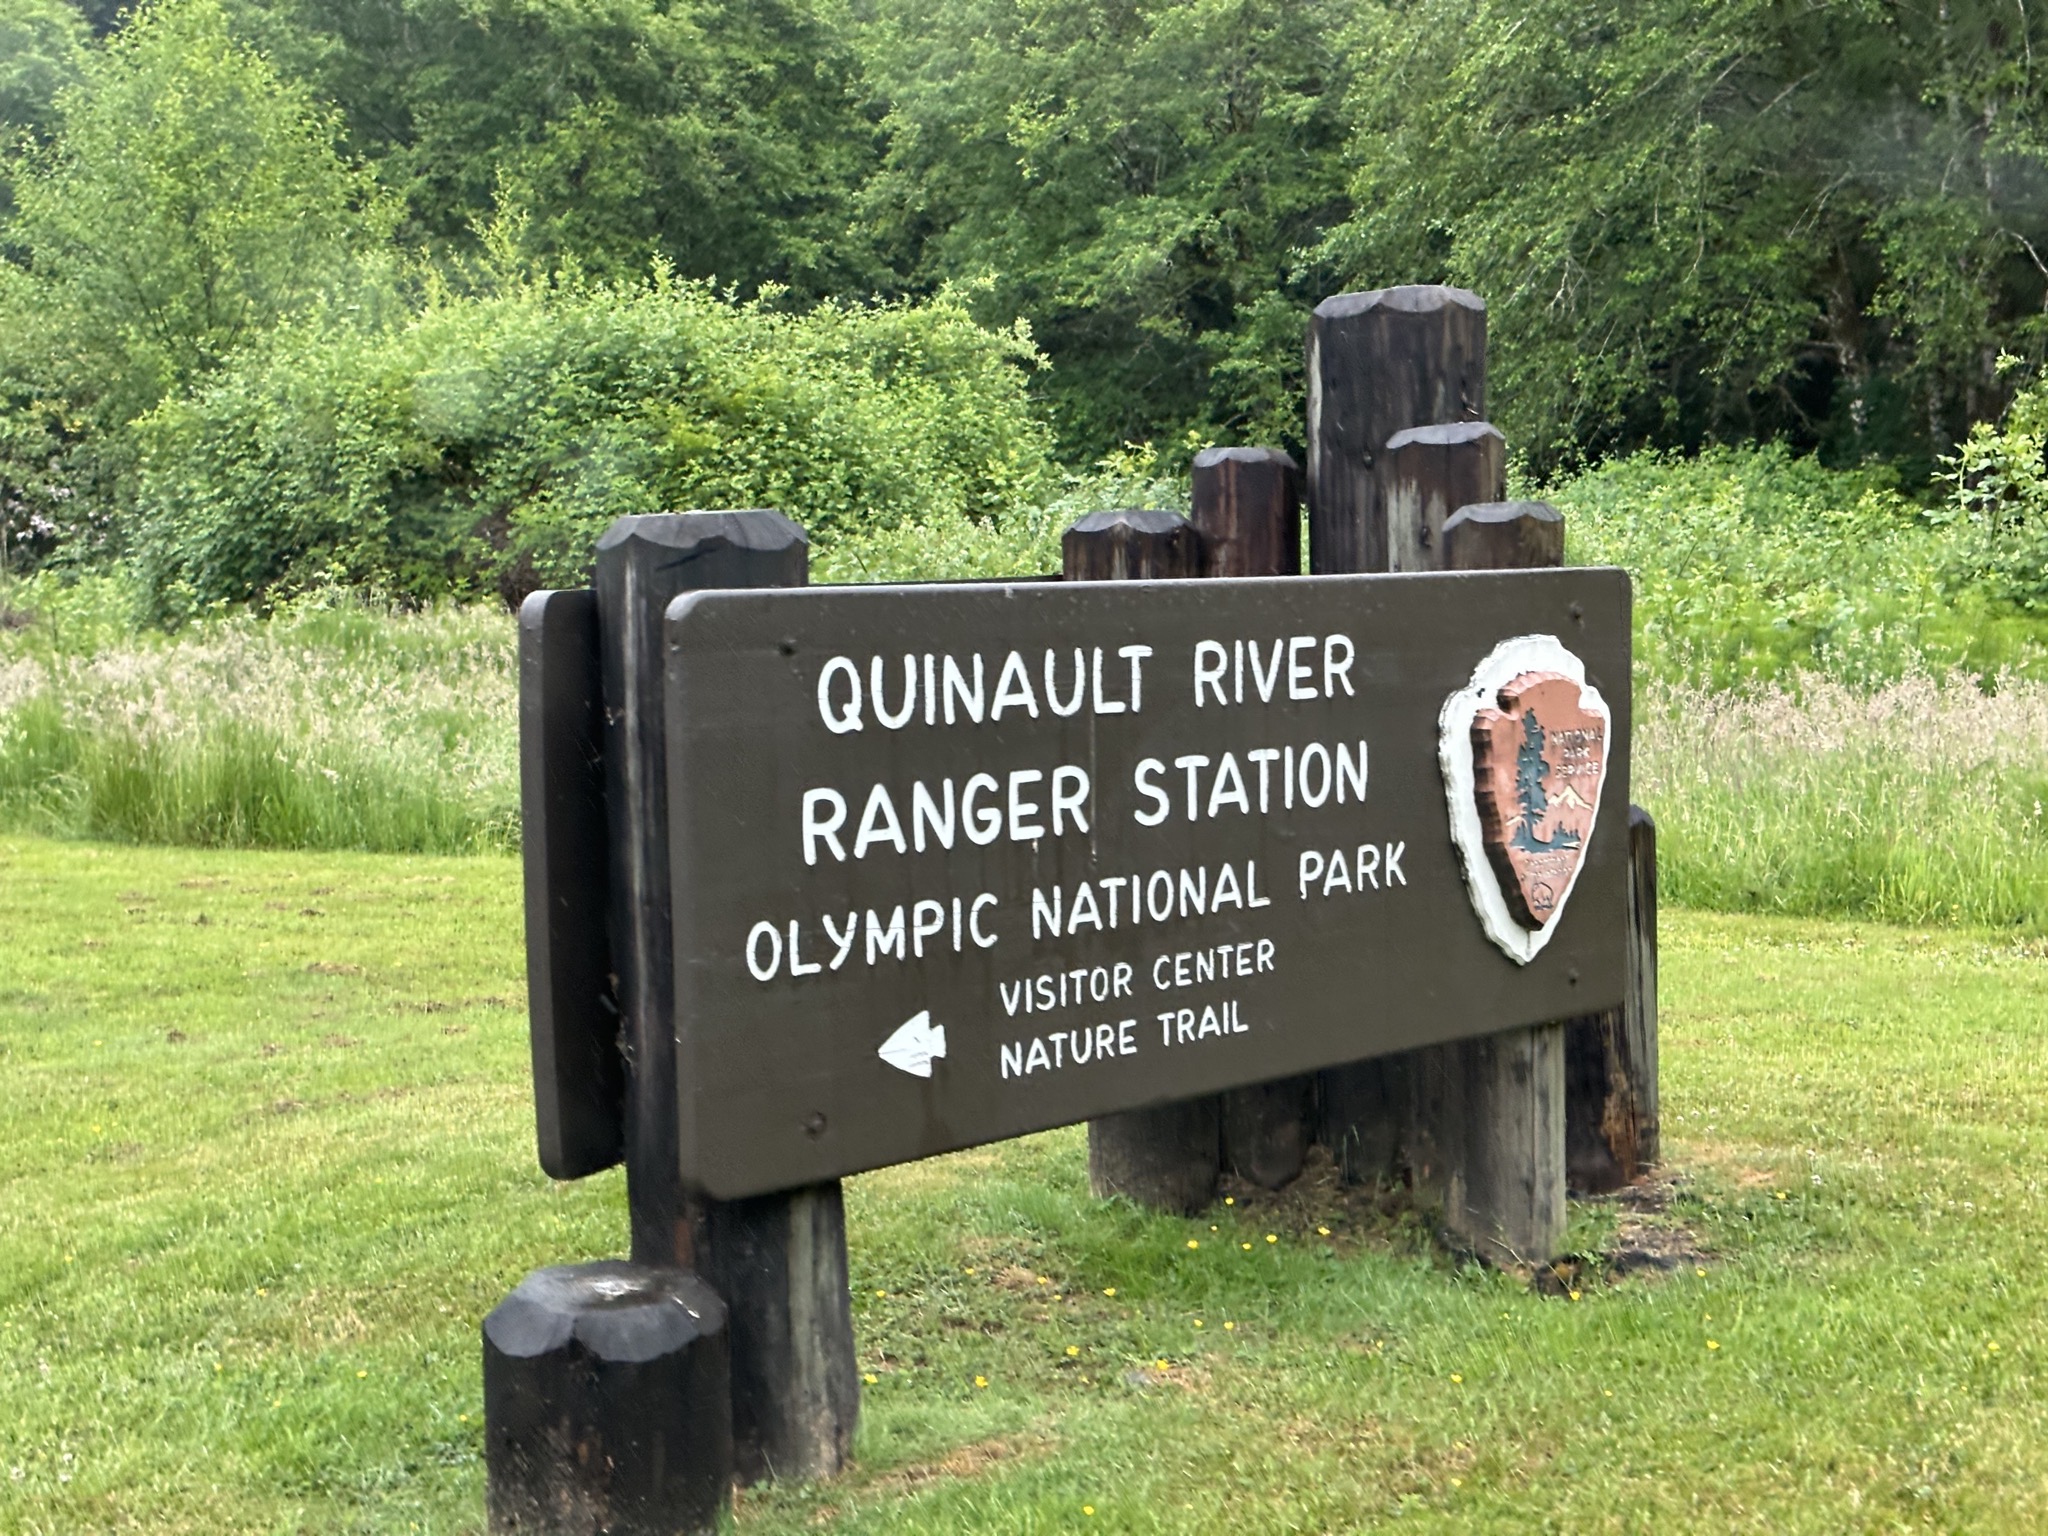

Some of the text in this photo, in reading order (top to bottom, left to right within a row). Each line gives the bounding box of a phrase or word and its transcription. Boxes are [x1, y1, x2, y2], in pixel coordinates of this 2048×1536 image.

[817, 633, 1356, 734] QUINAULT RIVER
[1551, 729, 1602, 746] NATIONAL
[1555, 760, 1599, 778] SERVICE
[1563, 746, 1590, 758] PARK
[801, 739, 1369, 866] RANGER STATION
[745, 840, 1408, 982] OLYMPIC NATIONAL PARK
[999, 938, 1276, 1017] VISITOR CENTER
[1000, 999, 1250, 1080] NATURE TRAIL
